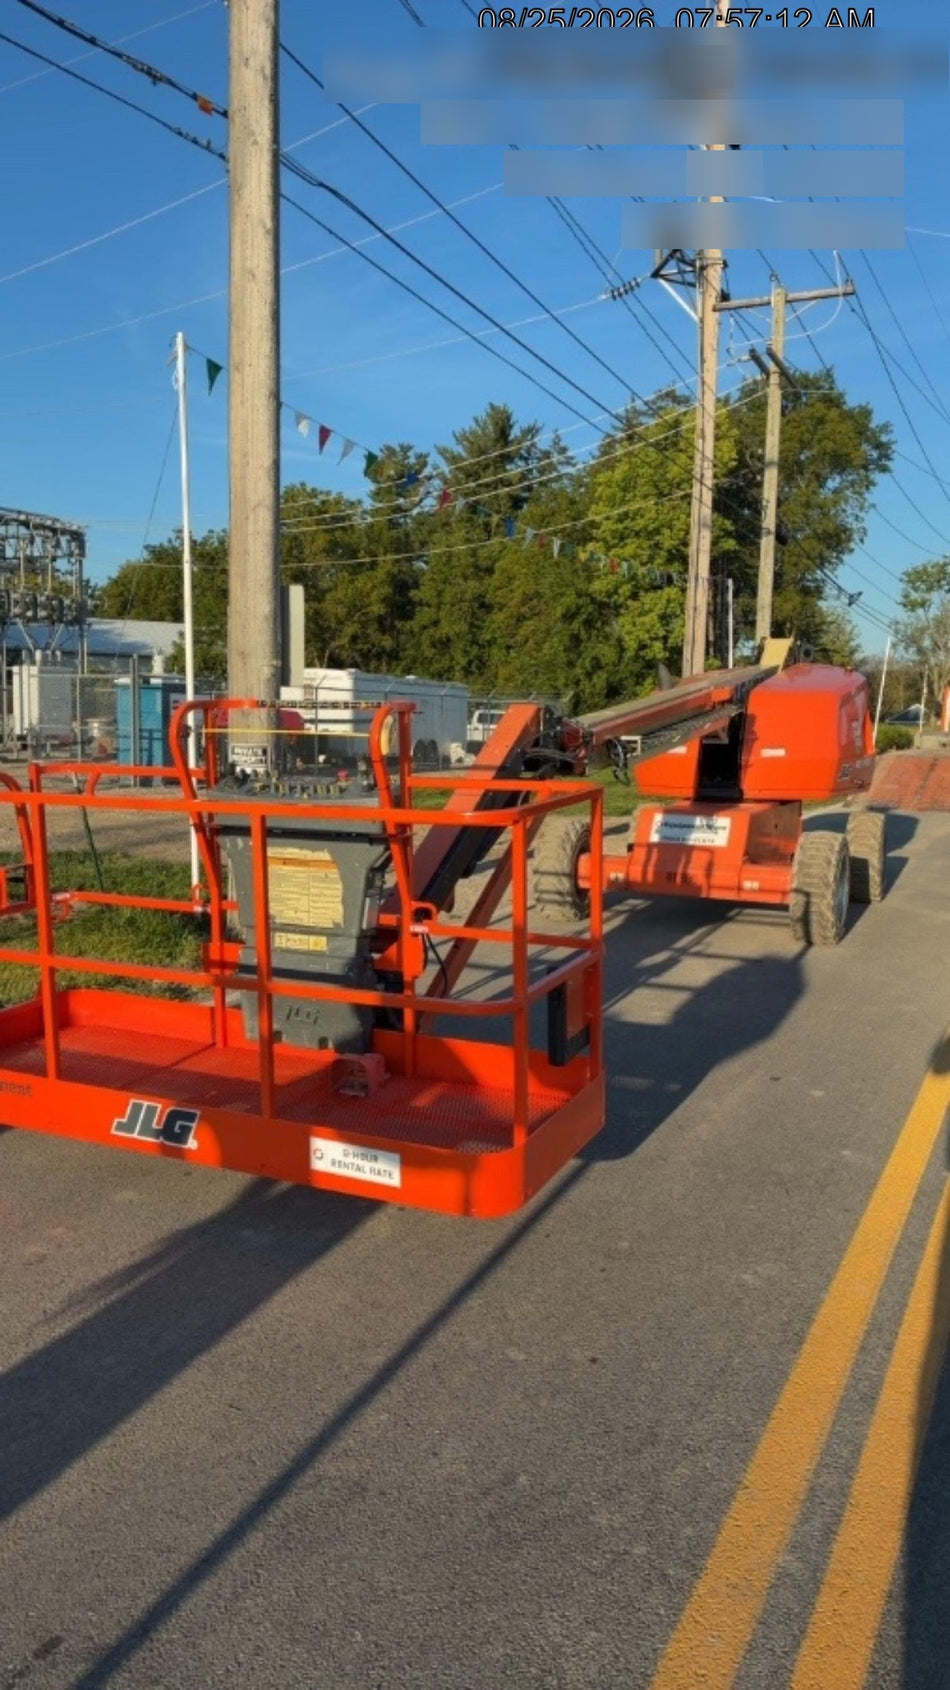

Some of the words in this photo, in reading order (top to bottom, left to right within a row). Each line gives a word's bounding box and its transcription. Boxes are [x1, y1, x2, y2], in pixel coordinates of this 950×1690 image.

[111, 1099, 199, 1147] JLG
[330, 1158, 367, 1175] RENTAL
[369, 1168, 395, 1180] RATE
